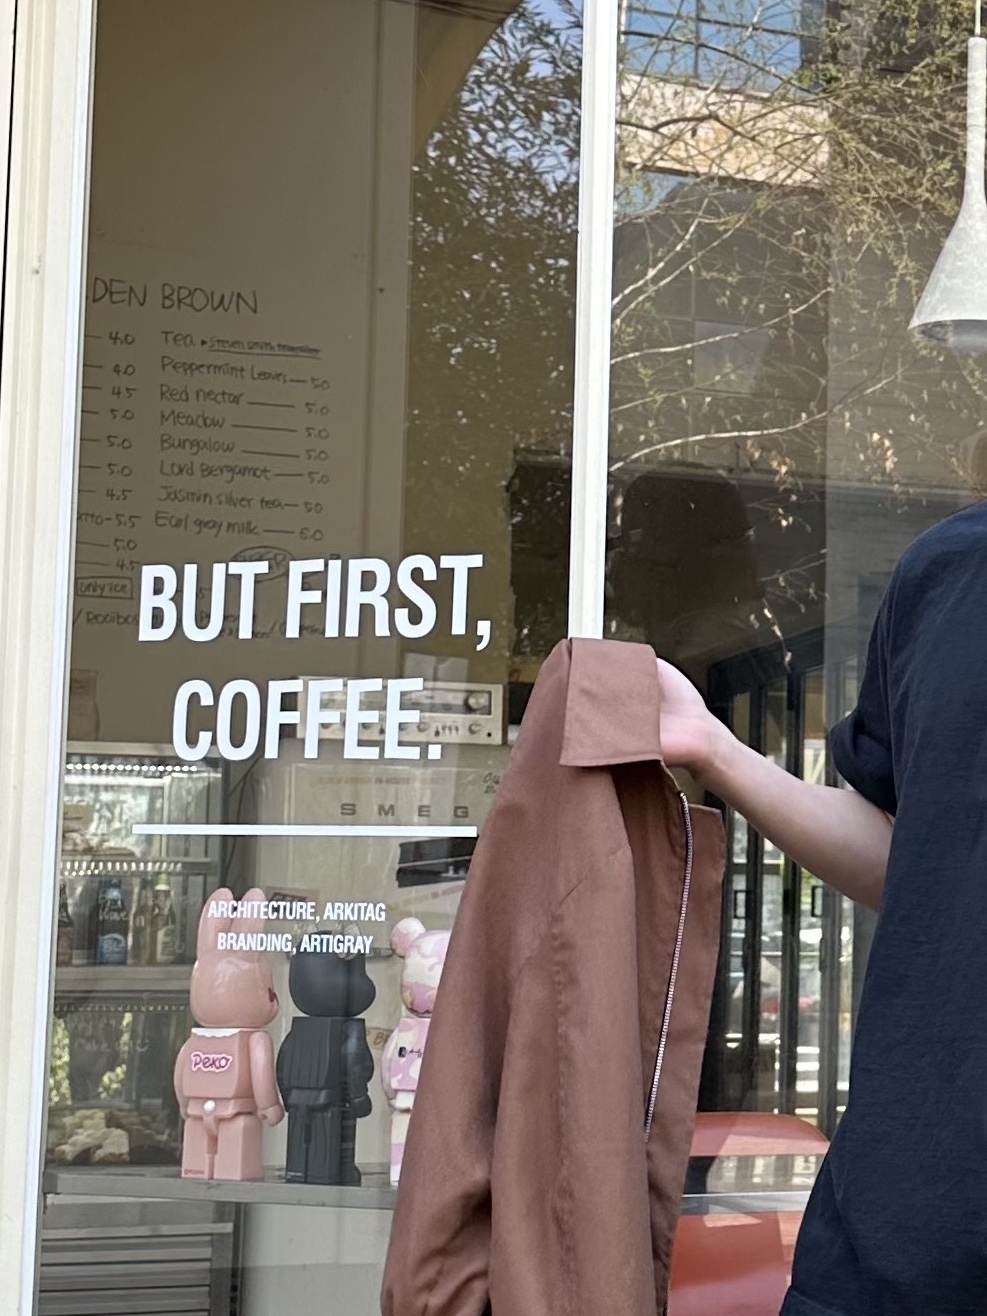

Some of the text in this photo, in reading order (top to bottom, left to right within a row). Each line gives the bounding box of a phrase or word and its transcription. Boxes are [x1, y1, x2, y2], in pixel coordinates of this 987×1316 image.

[160, 283, 258, 314] BROWN
[160, 331, 196, 348] Tea
[160, 355, 246, 379] Peppermint
[160, 383, 190, 403] Red
[160, 409, 226, 429] Meadow
[160, 433, 236, 455] Bungalow
[200, 463, 271, 484] Bergamot
[138, 562, 269, 642] BUT
[285, 553, 492, 651] FIRST,
[172, 677, 443, 761] COFFEE.
[340, 803, 469, 818] SMEG
[208, 901, 386, 922] ARCHITECTURE, ARKITAG
[217, 932, 373, 954] BRANDING, ARTIGRAY
